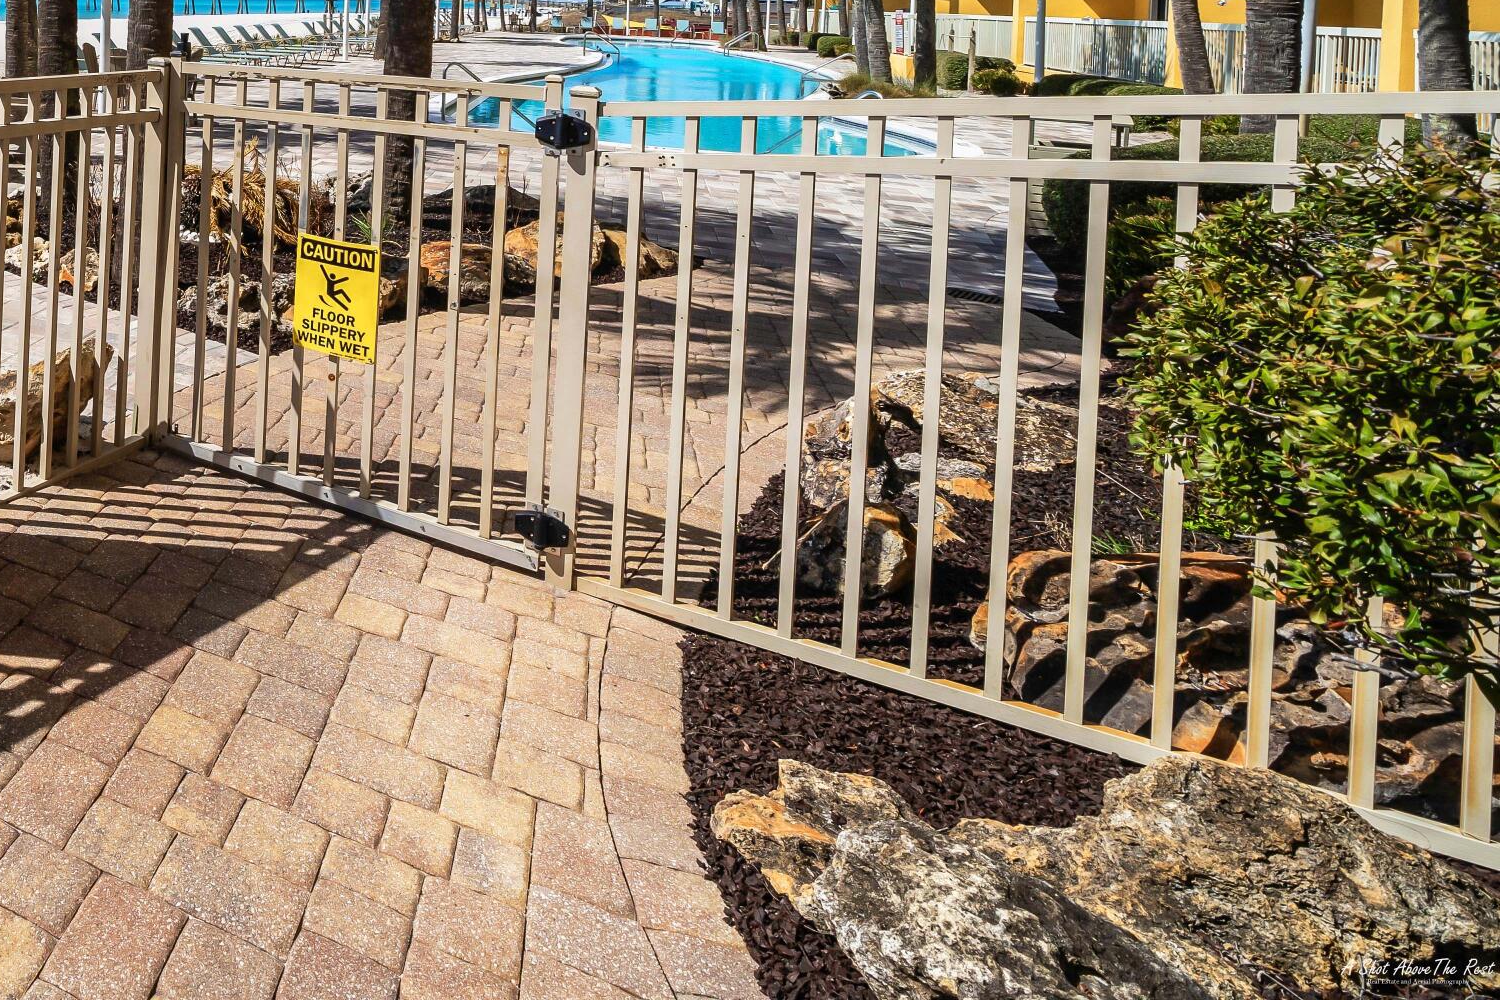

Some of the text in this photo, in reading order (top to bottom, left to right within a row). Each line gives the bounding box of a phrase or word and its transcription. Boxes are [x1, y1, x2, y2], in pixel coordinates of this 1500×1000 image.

[303, 242, 373, 268] CAUTION
[302, 318, 366, 342] SLIPPERY
[312, 308, 355, 327] FLOOR
[298, 330, 335, 350] WHEN
[340, 341, 369, 356] WET
